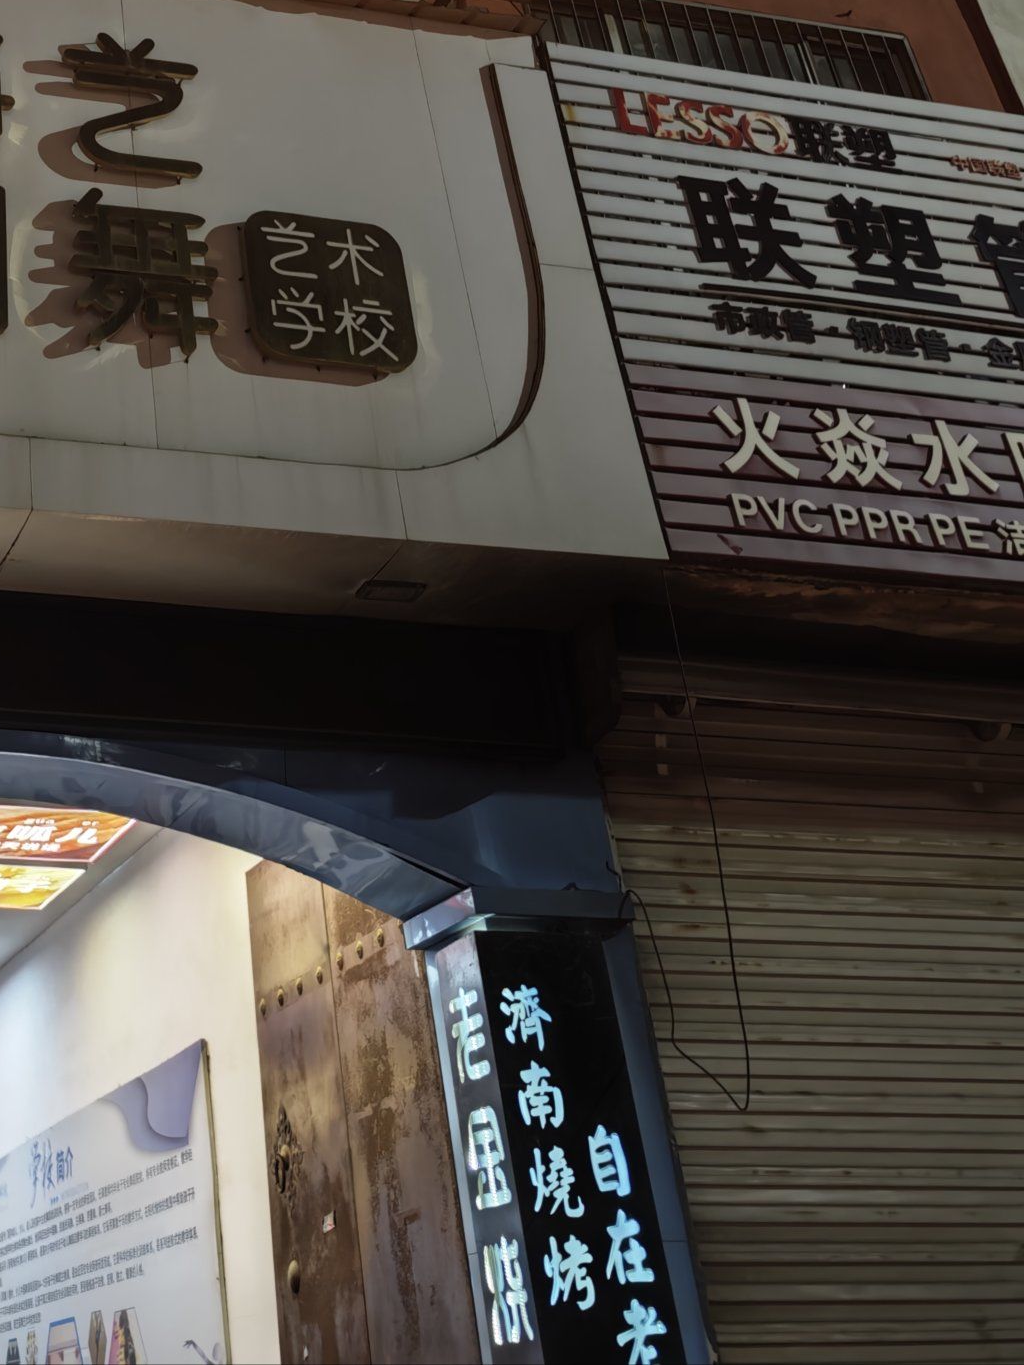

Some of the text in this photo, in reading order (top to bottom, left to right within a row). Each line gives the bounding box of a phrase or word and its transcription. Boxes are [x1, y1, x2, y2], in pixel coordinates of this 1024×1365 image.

[610, 87, 790, 155] LESSO
[260, 219, 385, 285] 艺术
[270, 287, 399, 362] 学校
[711, 397, 1024, 497] 火焱水
[729, 492, 824, 535] PVC
[832, 502, 924, 547] PPR
[927, 513, 991, 552] PE
